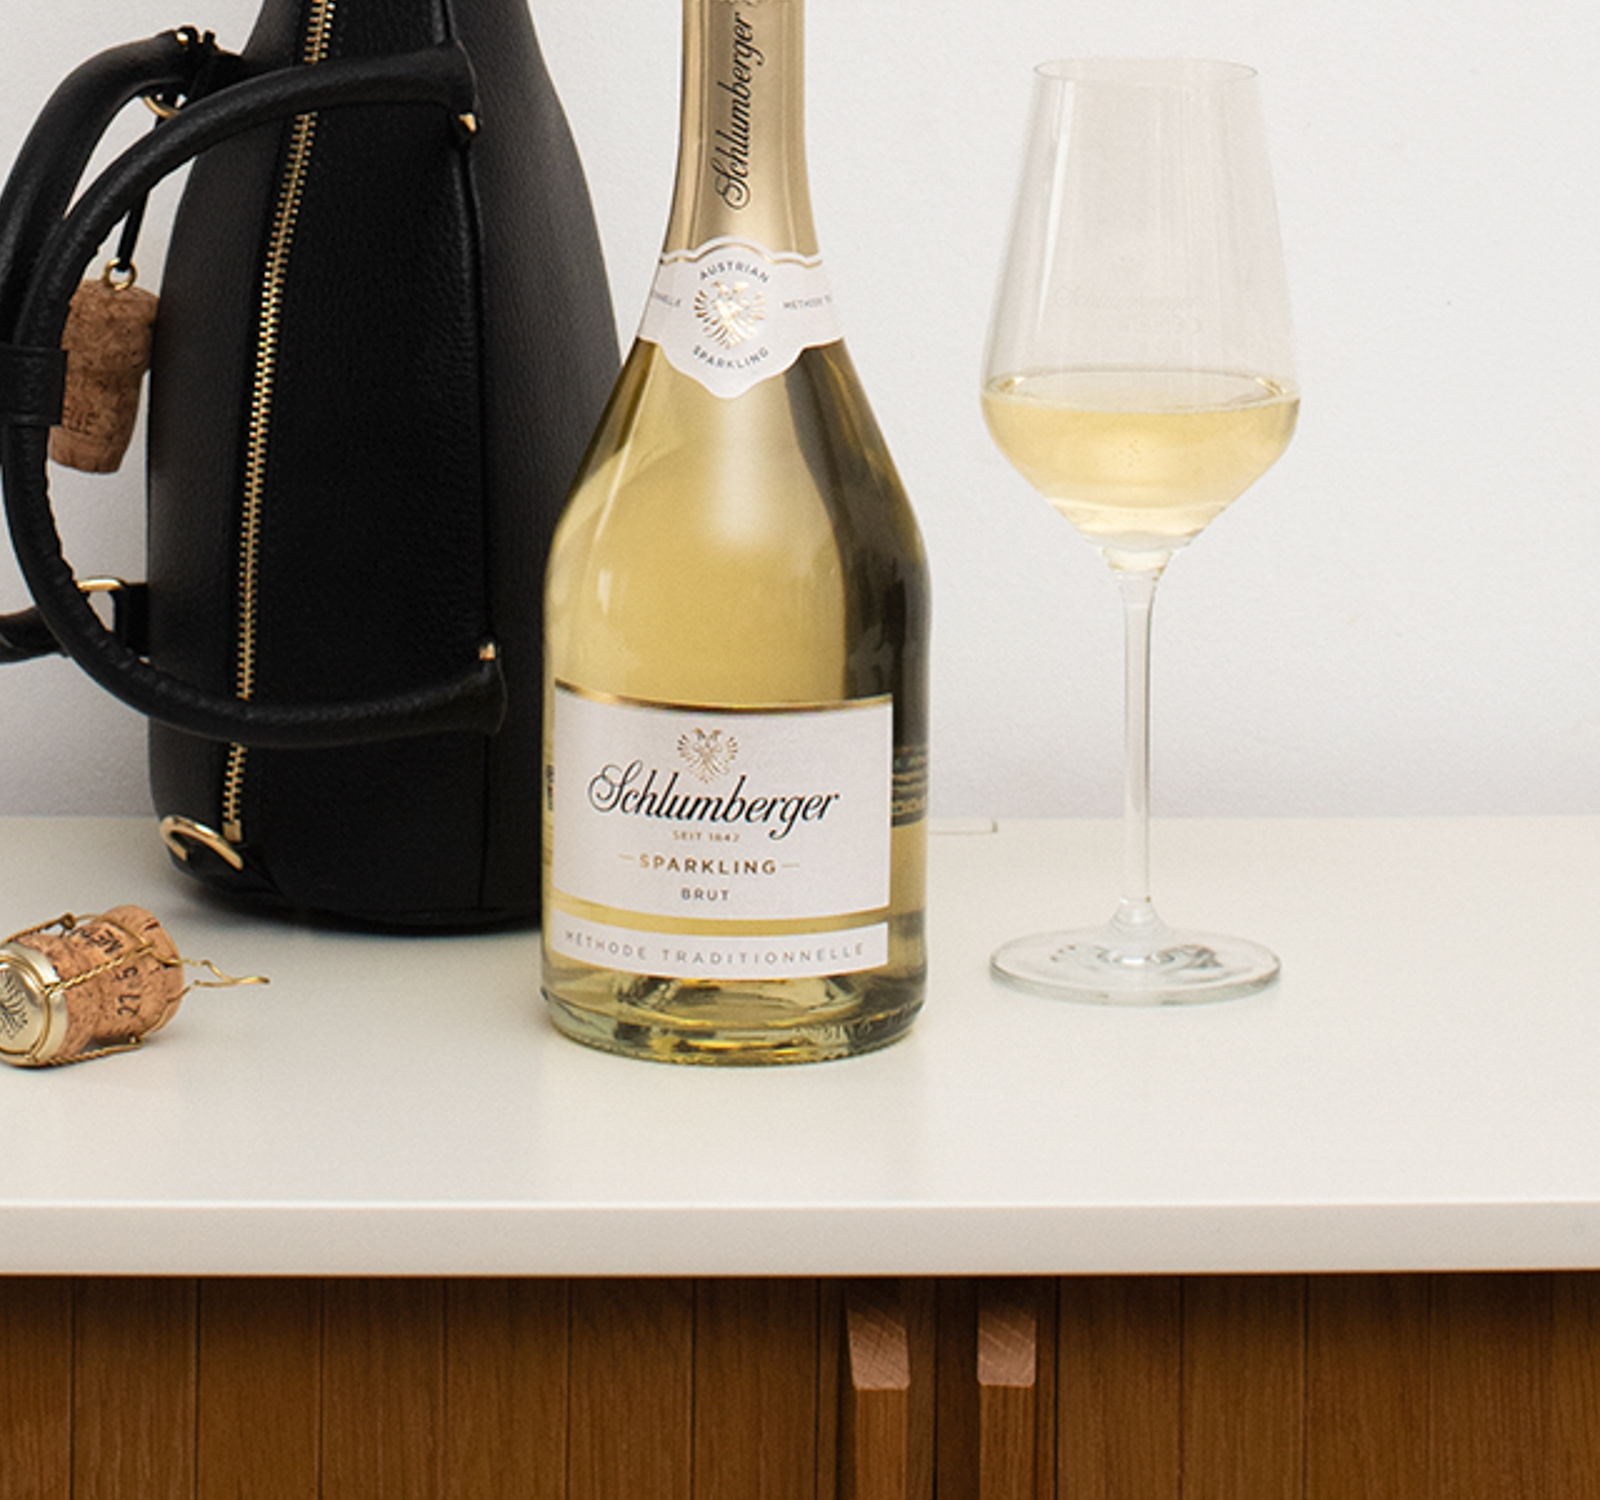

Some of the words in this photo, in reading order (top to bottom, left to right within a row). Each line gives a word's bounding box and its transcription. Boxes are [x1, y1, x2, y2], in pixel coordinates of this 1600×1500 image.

[710, 12, 765, 210] Schlumberger
[699, 260, 770, 283] AUSTRIAN
[692, 344, 769, 369] SPARKLING
[587, 759, 840, 840] Schlumberger
[672, 829, 702, 841] SEIT
[639, 853, 777, 875] SPARKLING
[681, 887, 730, 902] BRUT
[662, 941, 864, 965] TRADITIONNELLE
